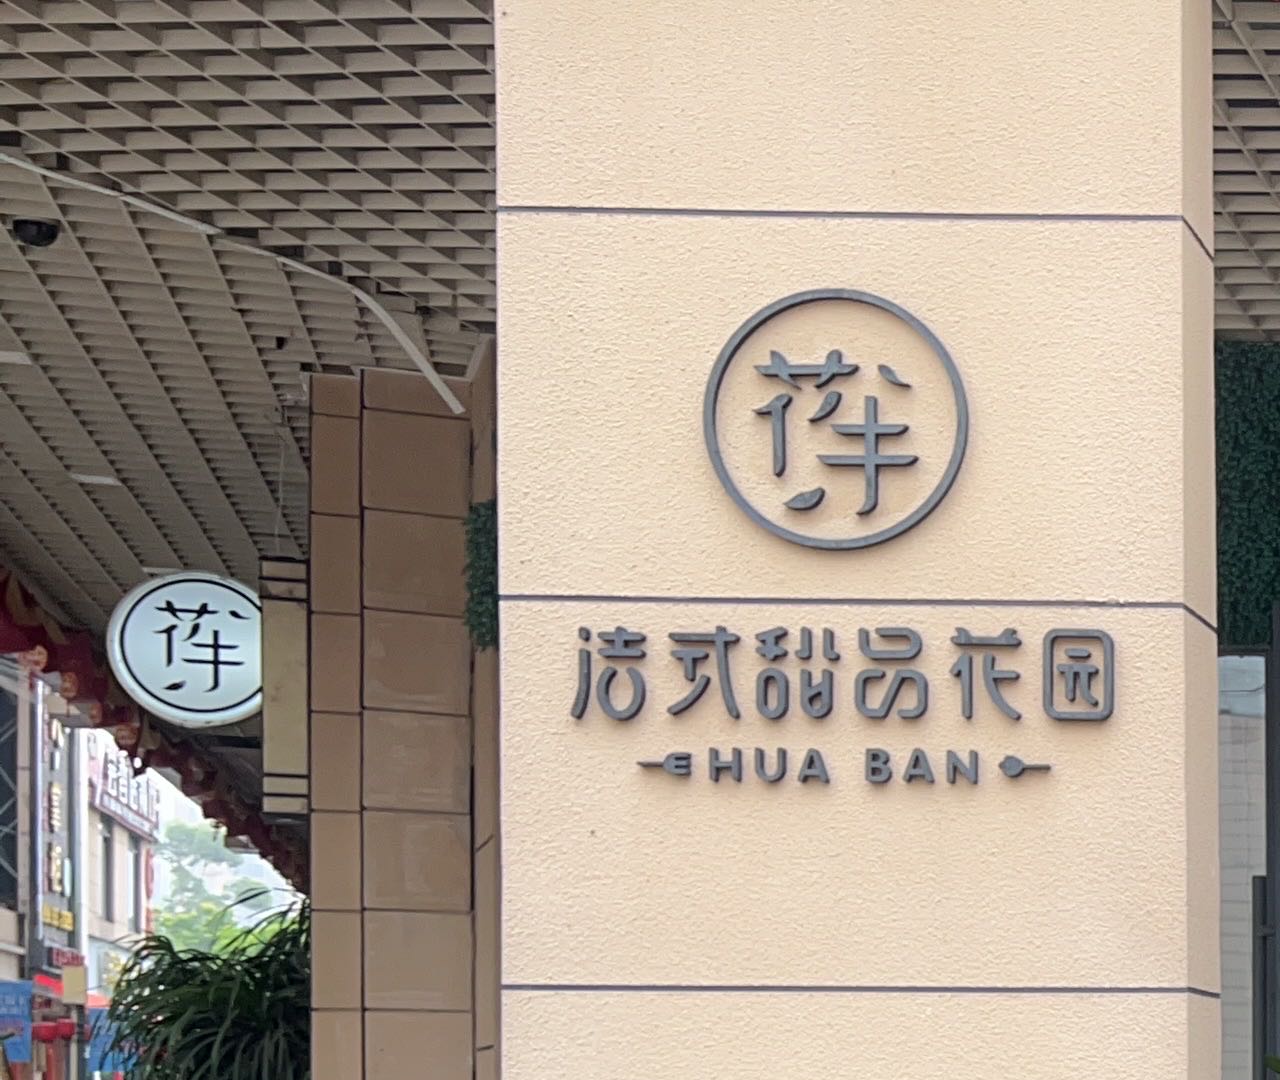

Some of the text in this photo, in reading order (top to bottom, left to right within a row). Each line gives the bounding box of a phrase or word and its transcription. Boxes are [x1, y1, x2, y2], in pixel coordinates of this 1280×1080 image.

[571, 626, 1116, 721] 法式甜品花园
[709, 747, 980, 784] HUA BAN
